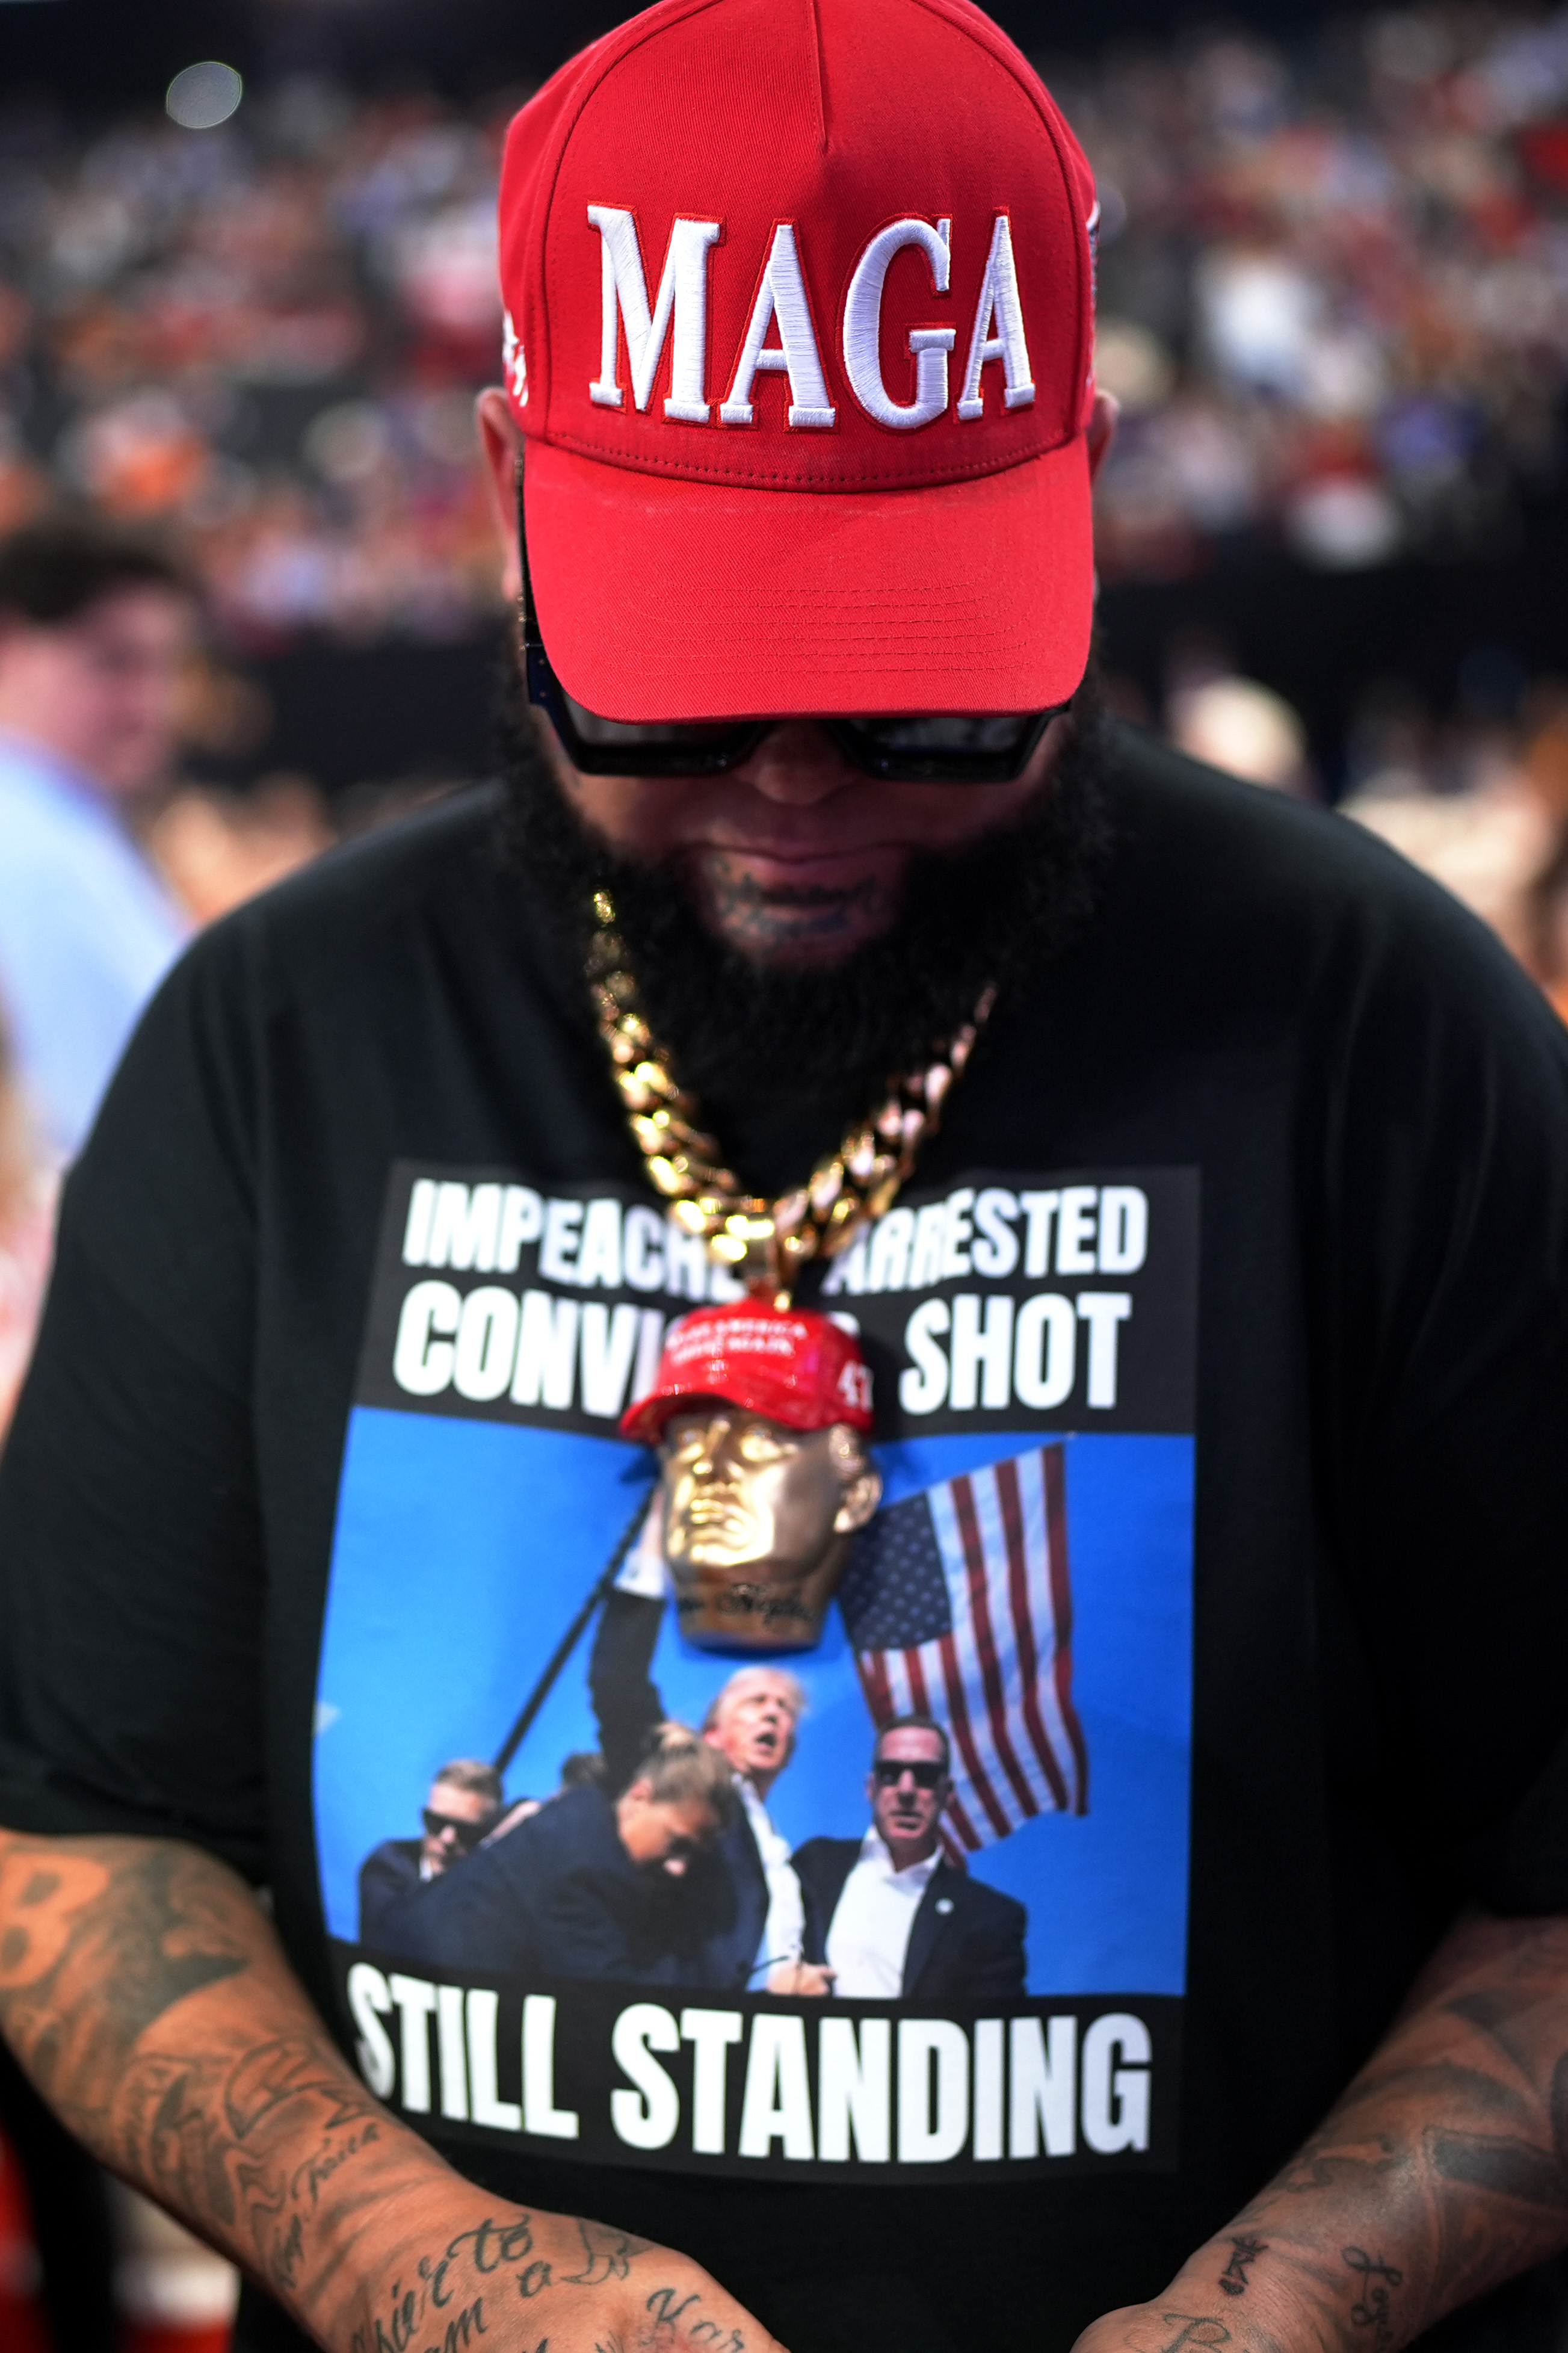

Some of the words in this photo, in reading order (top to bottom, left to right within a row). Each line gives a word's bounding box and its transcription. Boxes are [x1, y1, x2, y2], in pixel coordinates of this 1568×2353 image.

[587, 203, 1035, 429] MAGA
[402, 1178, 752, 1304] IMPEACH
[821, 1184, 1148, 1295] ARRESTED
[898, 1291, 1132, 1415] SHOT
[347, 1962, 579, 2140] STILL
[611, 2002, 1152, 2163] STANDING
